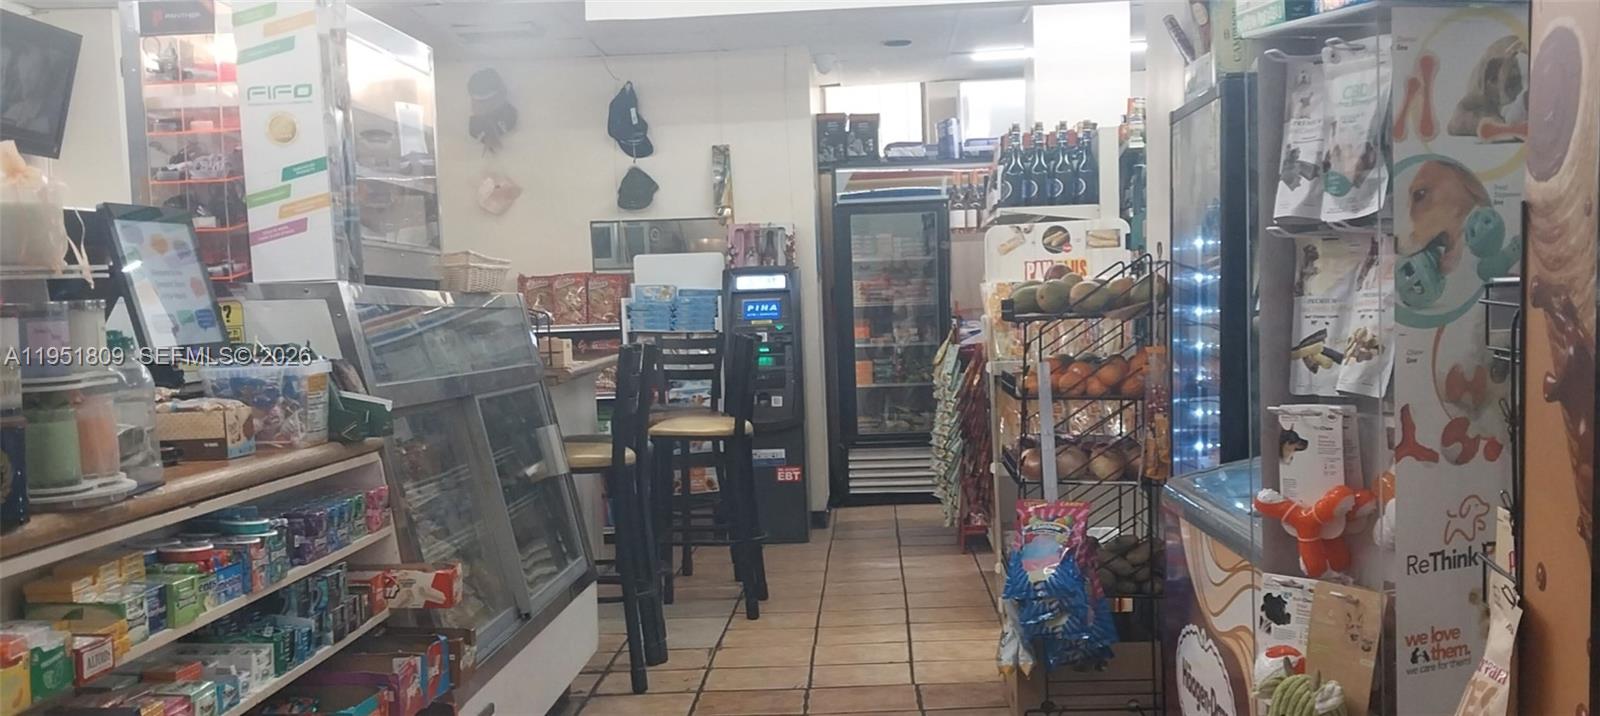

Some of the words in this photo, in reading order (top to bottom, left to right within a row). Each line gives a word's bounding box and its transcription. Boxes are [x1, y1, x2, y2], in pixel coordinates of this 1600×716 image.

[247, 84, 313, 101] FIFO
[777, 471, 801, 481] EBT
[1406, 546, 1480, 576] ReThink
[1405, 634, 1428, 648] we
[1431, 626, 1461, 643] love
[1430, 644, 1471, 661] them.
